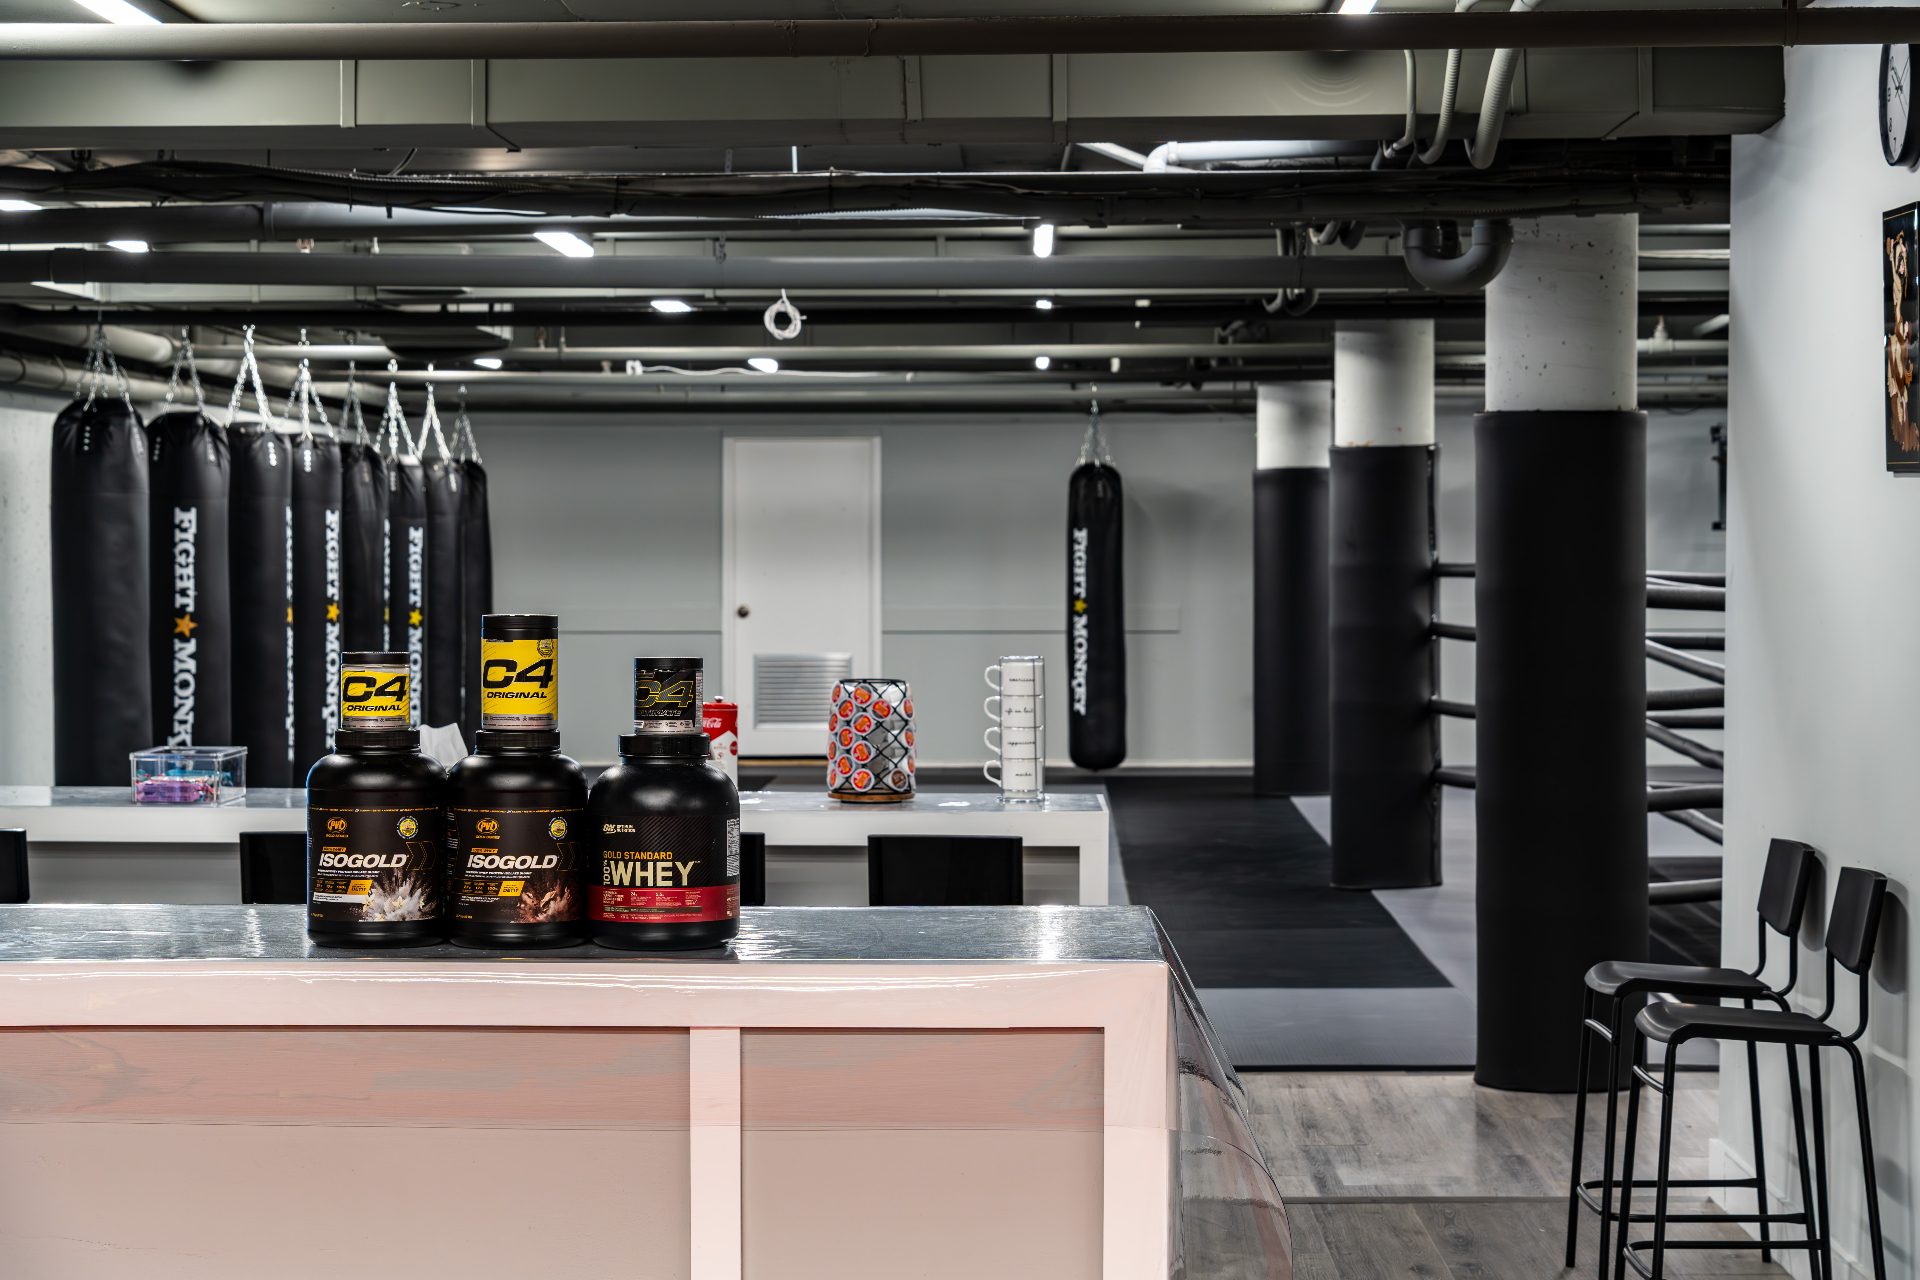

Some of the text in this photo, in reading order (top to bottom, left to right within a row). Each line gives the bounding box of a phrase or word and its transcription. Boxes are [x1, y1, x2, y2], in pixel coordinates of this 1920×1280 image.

[325, 510, 340, 601] FIGHT
[167, 507, 197, 756] FIGHT MONK
[408, 526, 423, 729] FIGHT MONKE
[1071, 528, 1088, 716] FIGHT MONKEY
[482, 659, 553, 689] C4
[343, 675, 407, 703] C4
[634, 680, 693, 708] C4
[319, 853, 408, 868] ISOGOLD
[467, 854, 558, 869] ISOGOLD
[603, 850, 672, 860] GOLD STANDARD
[603, 859, 694, 886] 100% WHEY
